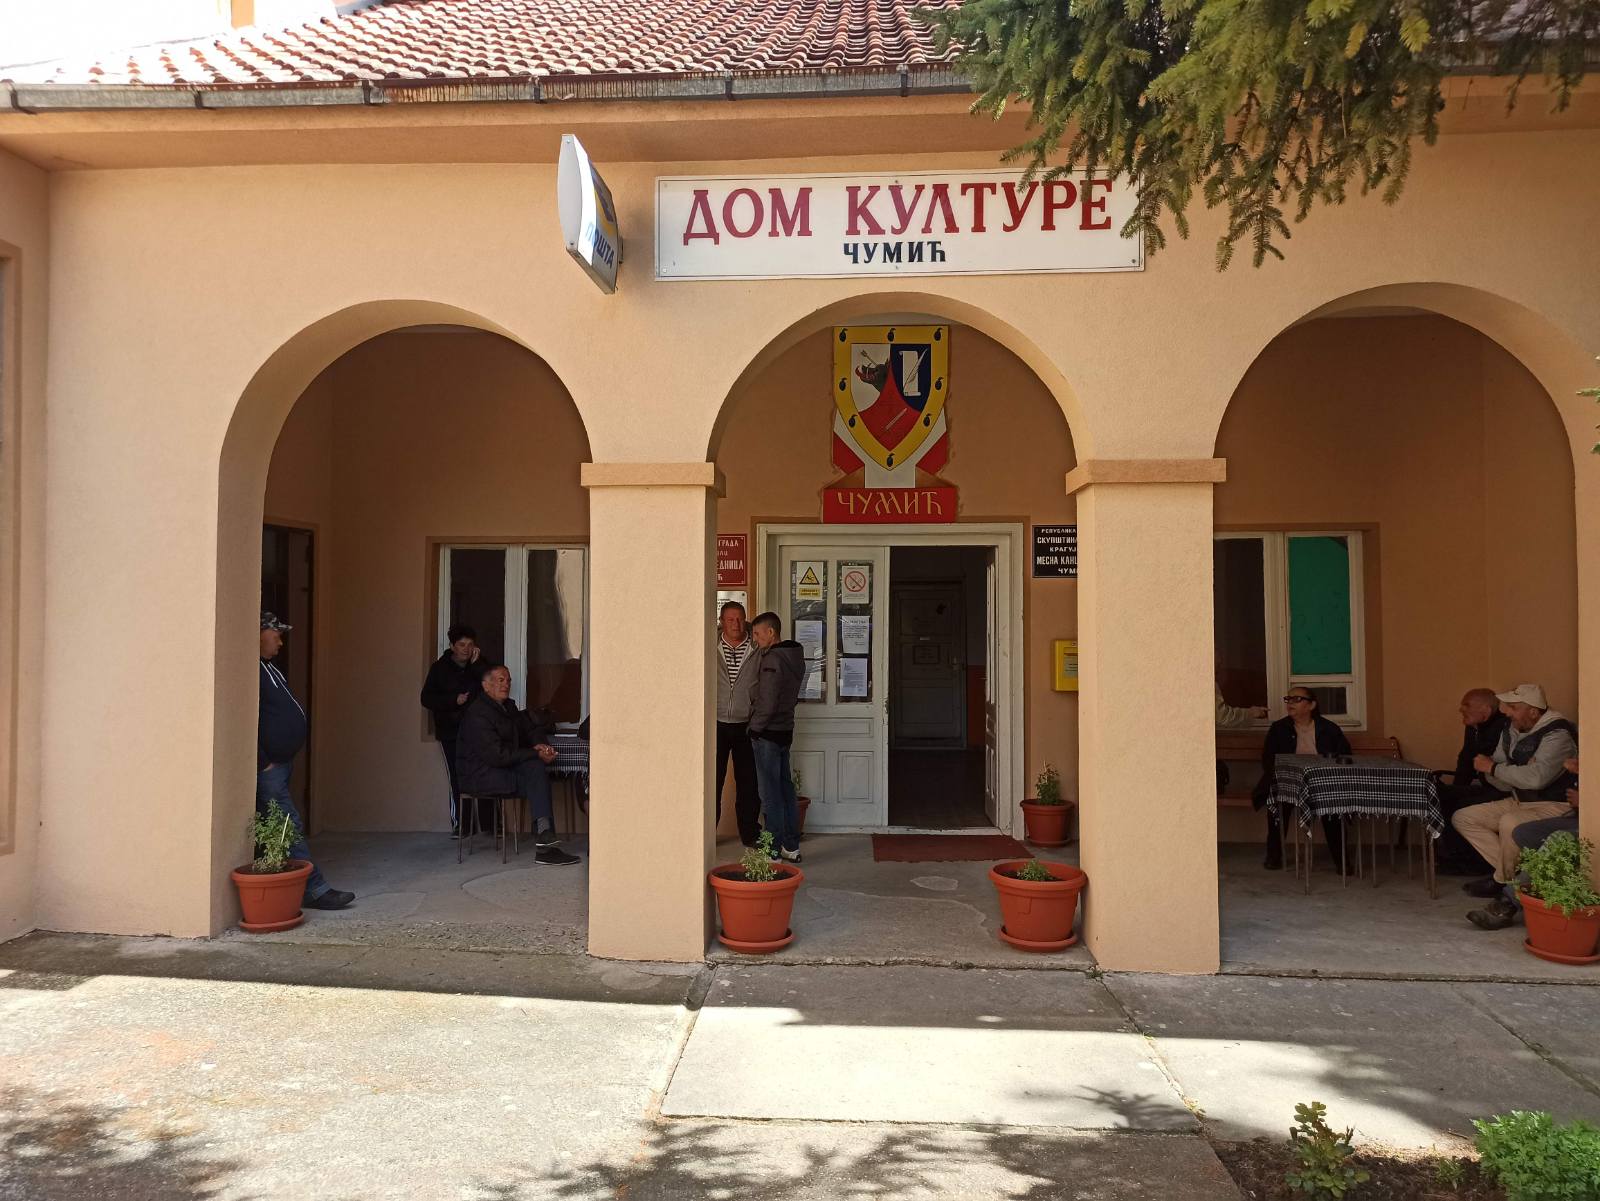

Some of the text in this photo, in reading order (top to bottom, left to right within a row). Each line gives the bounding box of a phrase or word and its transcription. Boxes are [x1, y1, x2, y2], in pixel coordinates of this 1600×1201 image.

[683, 178, 1113, 246] ДОМ КУЛТУРЕ
[585, 221, 615, 269] ПОШТА
[843, 241, 946, 265] ЧУМИЋ
[837, 491, 943, 515] ЧУМИЋ
[1036, 555, 1059, 565] МЕСНА
